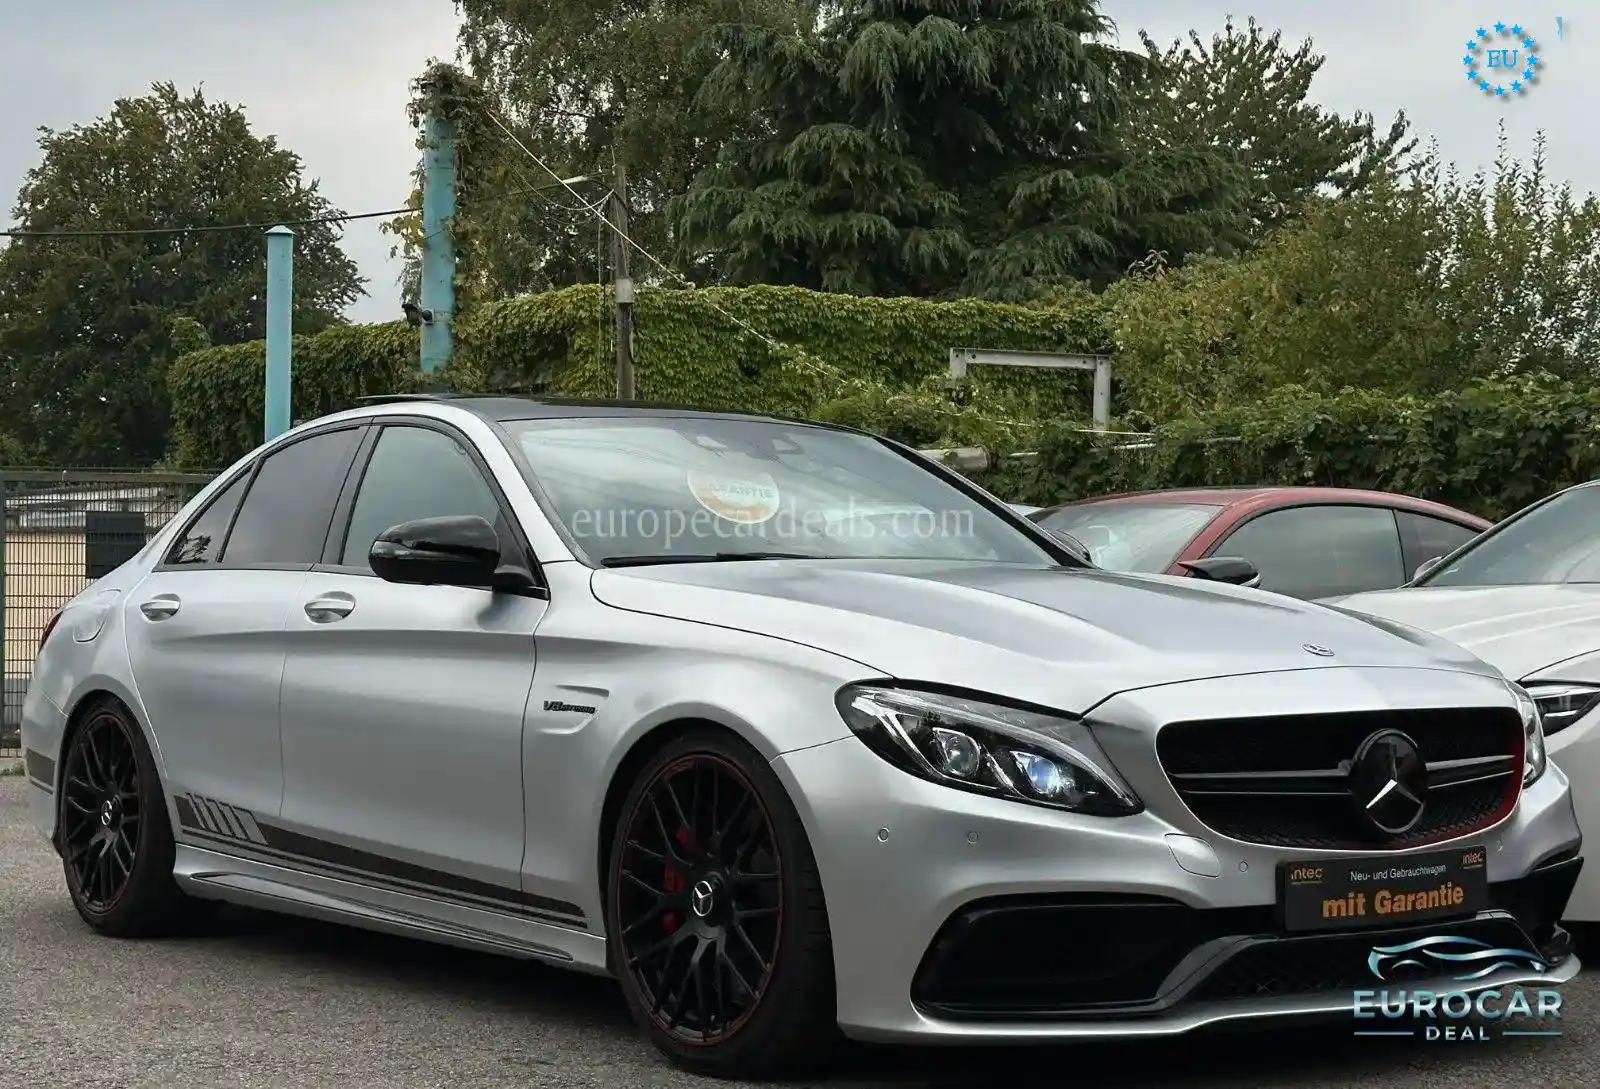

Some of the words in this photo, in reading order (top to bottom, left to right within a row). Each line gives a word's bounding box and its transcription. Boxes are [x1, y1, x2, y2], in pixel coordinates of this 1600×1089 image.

[1290, 866, 1324, 880] intec
[1350, 870, 1371, 882] Neu-
[1373, 870, 1388, 880] und
[1389, 863, 1446, 880] Gebrauchtwagen
[1322, 891, 1366, 917] mit
[1374, 881, 1464, 914] Garantie
